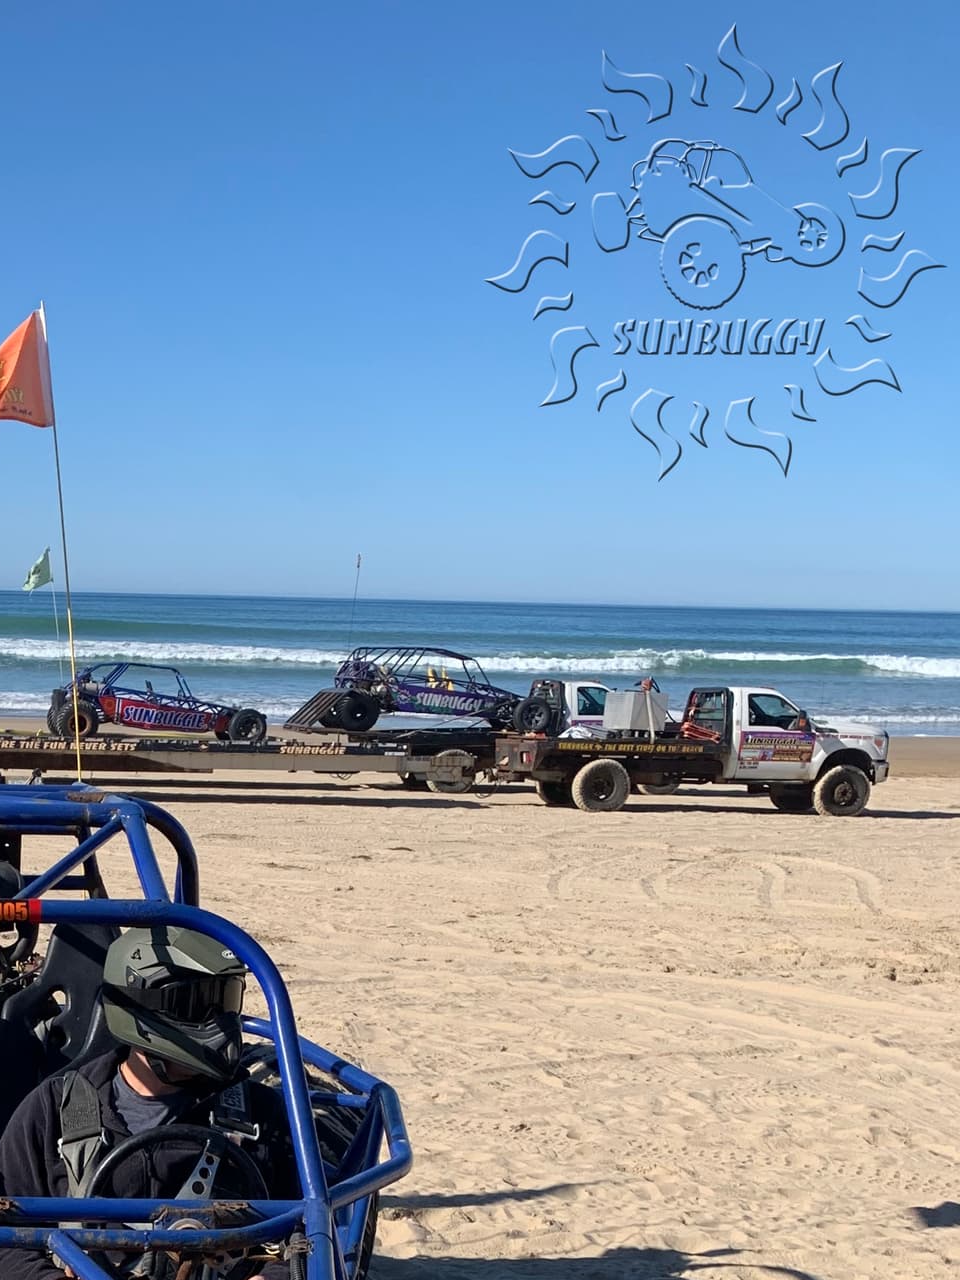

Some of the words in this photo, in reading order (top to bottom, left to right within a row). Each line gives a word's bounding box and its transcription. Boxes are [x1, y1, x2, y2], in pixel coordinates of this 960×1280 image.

[415, 692, 483, 711] SUNBUGGY
[123, 706, 205, 729] SUNBUGGIE
[19, 740, 40, 749] THE
[43, 740, 66, 750] FUN
[70, 741, 106, 750] NEVER
[110, 741, 137, 751] SETS
[280, 745, 346, 755] SUNBUGGIE
